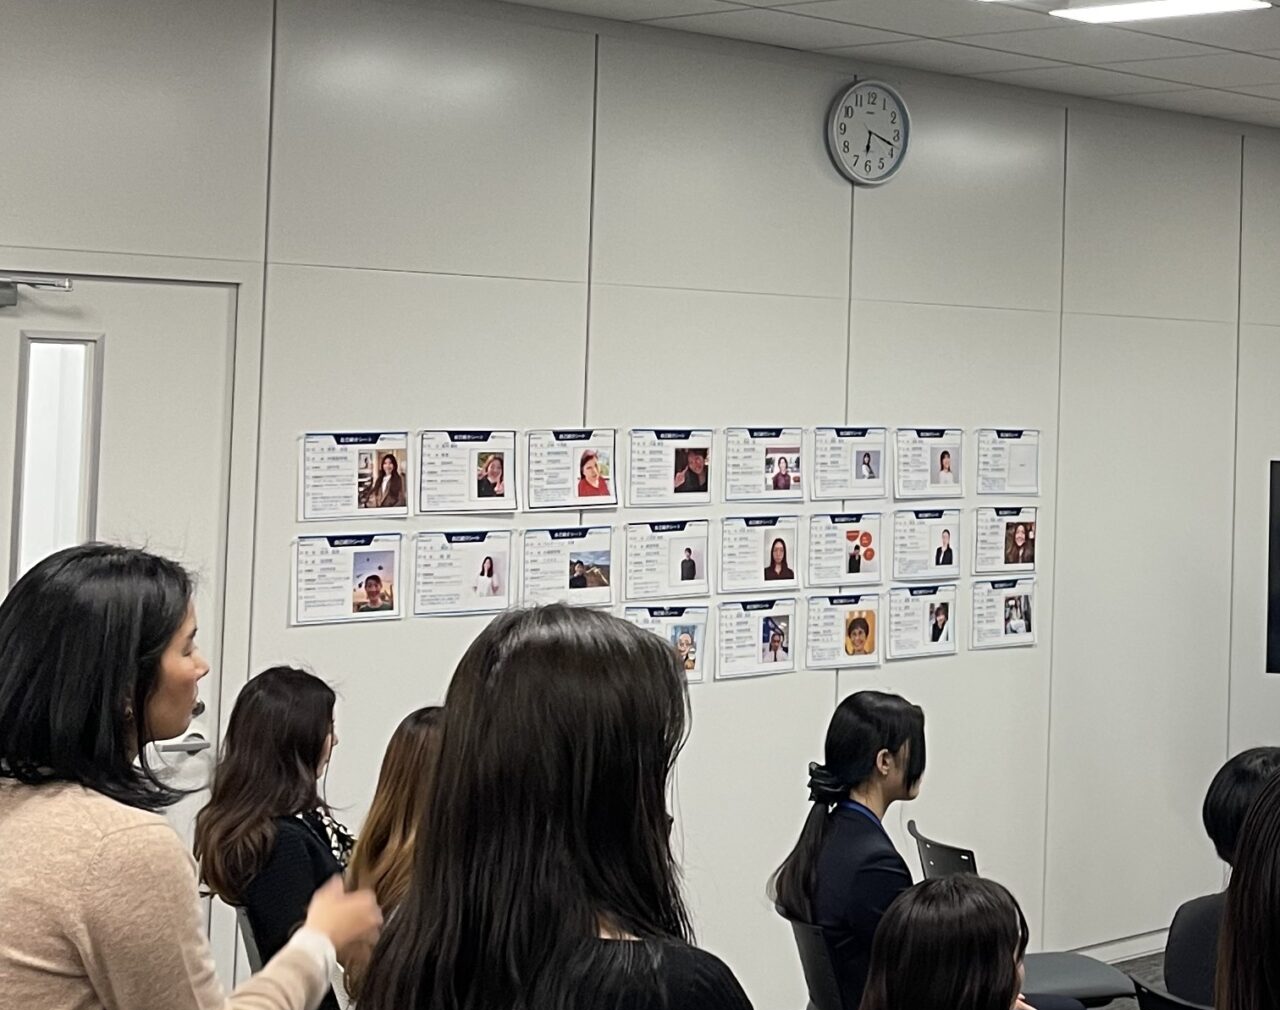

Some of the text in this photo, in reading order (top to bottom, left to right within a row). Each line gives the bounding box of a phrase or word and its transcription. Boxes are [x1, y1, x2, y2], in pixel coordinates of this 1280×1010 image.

[855, 94, 862, 107] 11
[867, 92, 877, 105] 12
[844, 106, 854, 118] 10
[890, 111, 896, 124] 2
[839, 122, 846, 135] 9
[893, 130, 900, 142] 3
[843, 140, 849, 153] 8
[853, 154, 859, 167] 7
[864, 160, 871, 173] 6
[878, 158, 884, 170] 5
